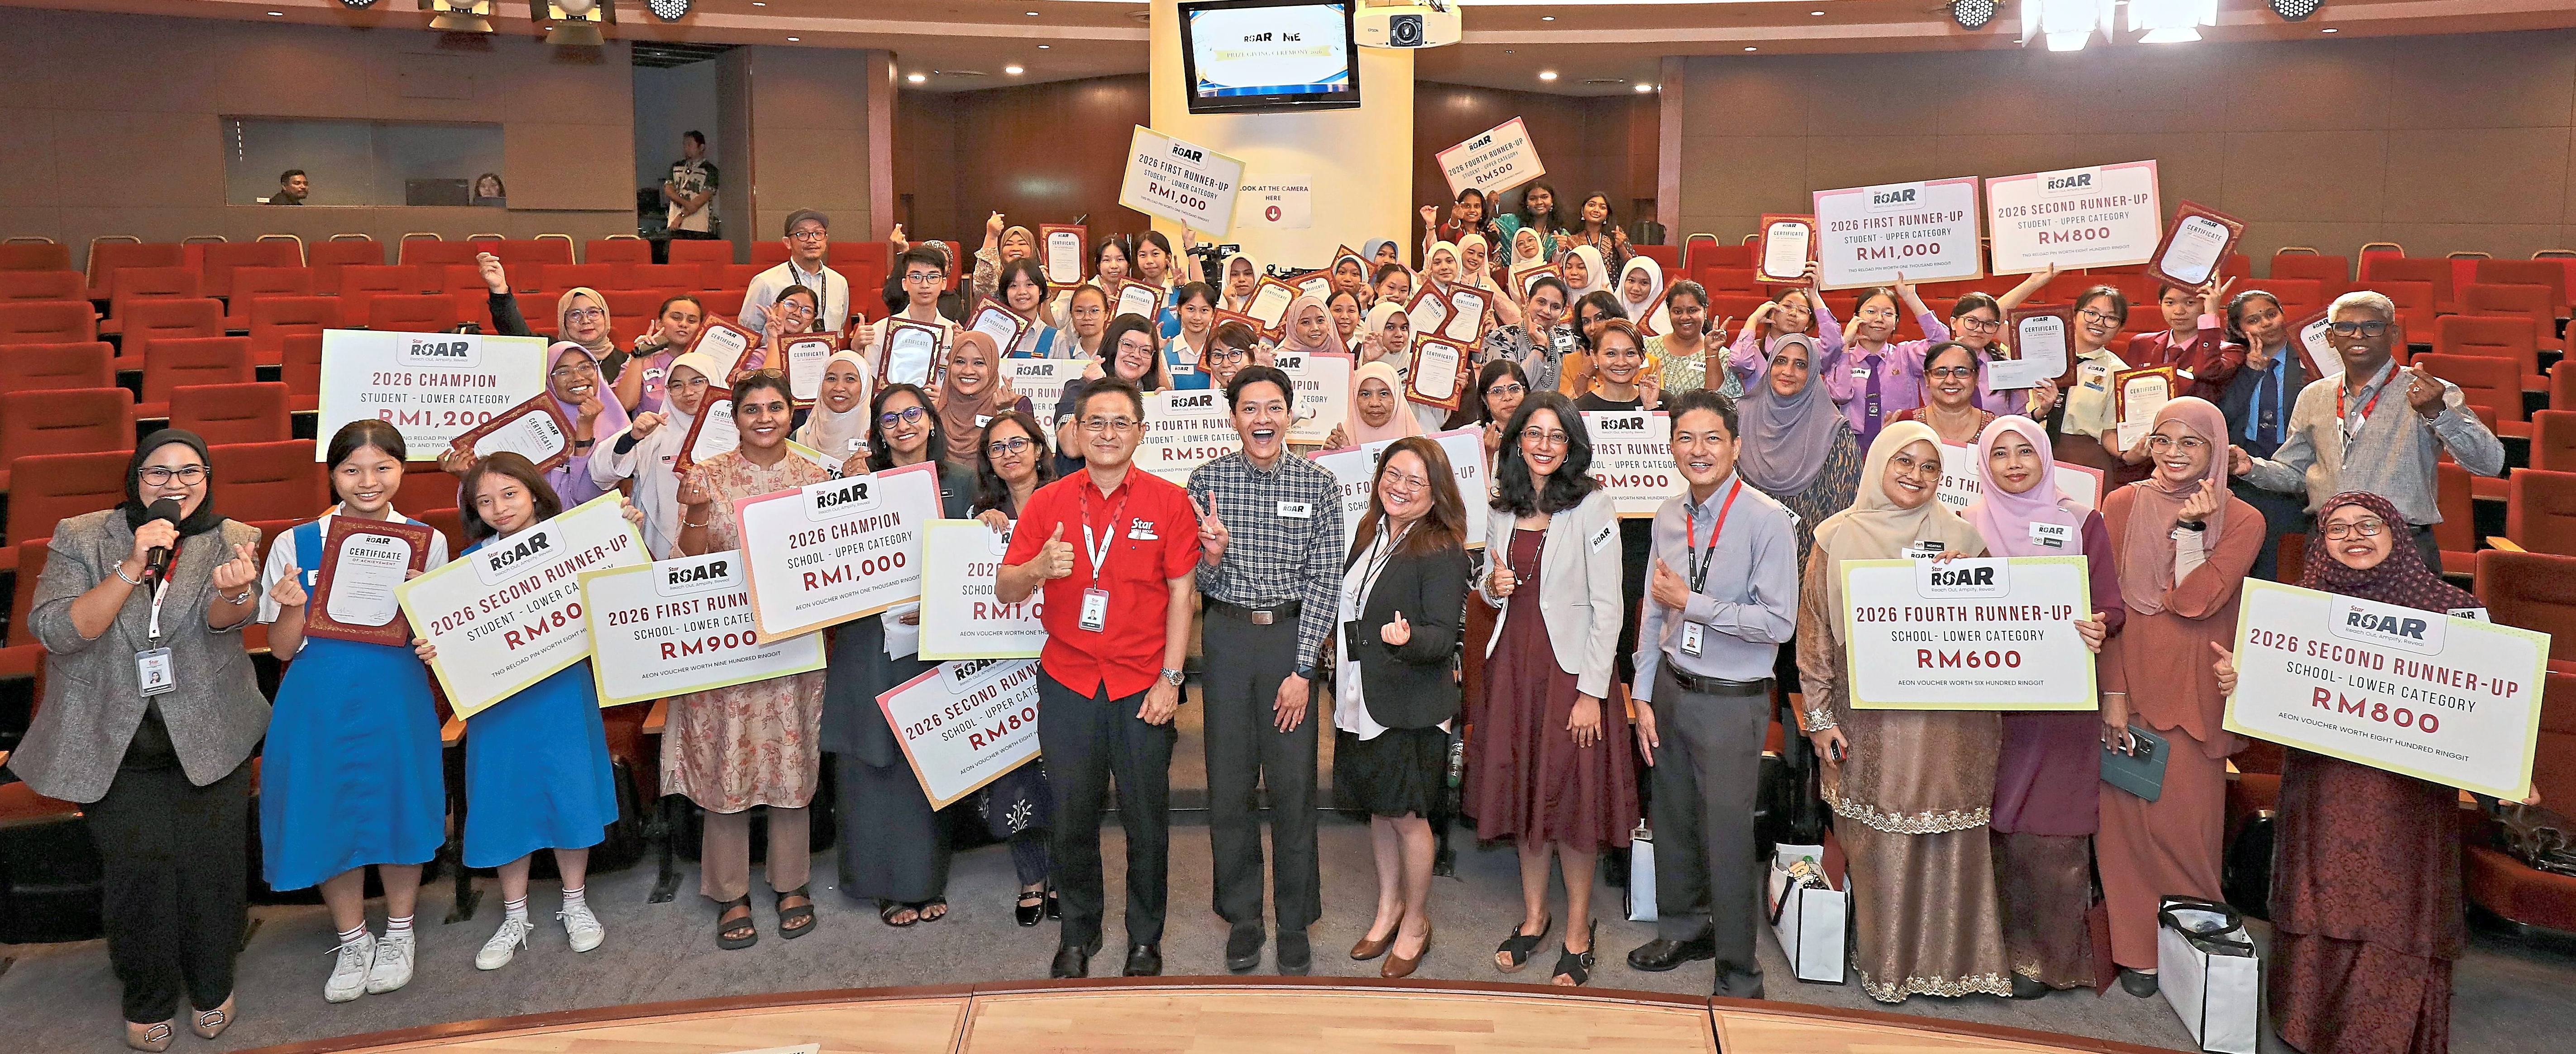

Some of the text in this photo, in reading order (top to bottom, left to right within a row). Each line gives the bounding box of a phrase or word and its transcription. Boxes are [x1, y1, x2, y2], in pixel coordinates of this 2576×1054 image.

[1244, 32, 1272, 42] ROAR
[1172, 143, 1203, 162] ROAR
[1469, 135, 1492, 151] ROAR
[1448, 138, 1523, 176] 2026 FOURTH RUNNER-UP
[1462, 151, 1518, 179] STUDENT UPPER CATEGORY
[1139, 154, 1158, 167] 2026
[1160, 161, 1182, 176] FIRST
[1184, 170, 1228, 191] RUNNER-UP
[1475, 163, 1512, 184] RM500
[2048, 173, 2091, 190] ROAR
[1144, 169, 1218, 200] STUDENT LOWER CATEGORY
[1149, 181, 1206, 210] RM1,000
[1874, 189, 1916, 204] ROAR
[1998, 193, 2148, 218] 2026 SECOND RUNNER-UP
[1831, 210, 1963, 232] 2026 FIRST RUNNER-UP
[2018, 211, 2129, 229] STUDENT UPPER CATEGORY
[1845, 228, 1951, 244] STUDENT UPPER CATEGORY
[2039, 227, 2110, 244] RM800
[2187, 224, 2222, 241] CERTIFICATE
[1857, 243, 1940, 261] RM1,000
[411, 342, 468, 357] ROAR
[373, 372, 496, 387] 2026 CHAMPION
[1016, 364, 1054, 376] ROAR
[361, 393, 510, 404] STUDENT LOWER CATEGORY
[1171, 395, 1212, 407] ROAR
[379, 409, 492, 428] RM1,200
[545, 420, 559, 435] ROAR
[1156, 420, 1197, 431] FOURTH
[1601, 417, 1644, 429] ROAR
[529, 418, 554, 450] CERTIFICATE
[1142, 434, 1208, 444] STUDENT LOWER
[1162, 447, 1229, 461] RM500
[1594, 473, 1668, 489] RM900
[816, 483, 868, 509] ROAR
[789, 511, 900, 549] 2026 CHAMPION
[1131, 517, 1154, 530] Star
[1593, 527, 1611, 546] ROAR
[349, 548, 401, 560] CERTIFICATE
[490, 532, 550, 571] ROAR
[788, 531, 912, 569] SCHOOL UPPER CATEGORY
[669, 561, 728, 585] ROAR
[803, 552, 906, 591] RM1,000
[1931, 567, 1994, 586] ROAR
[431, 534, 627, 636] 2026 SECOND RUNNER-UP
[467, 590, 563, 641] STUDENT LOWER
[608, 599, 699, 626] 2026 FIRST
[1857, 605, 2071, 622] 2026 FOURTH RUNNER-UP
[634, 618, 719, 640] SCHOOL- LOWER
[1892, 630, 2044, 642] SCHOOL- LOWER CATEGORY
[2346, 612, 2427, 641] ROAR
[660, 630, 757, 660] RM900
[660, 667, 689, 675] VOUCHER
[728, 655, 756, 664] HUNDRED
[757, 651, 781, 659] RINGGIT
[1917, 649, 2021, 668] RM600
[2250, 628, 2518, 698] 2026 SECOND RUNNER-UP
[2287, 661, 2476, 712] SCHOOL- LOWER CATEGORY
[906, 685, 997, 740] 2026 SECOND
[2312, 687, 2439, 733] RM800
[942, 699, 1015, 741] SCHOOL UPPER
[2278, 712, 2469, 762] AEON VOUCHER WORTH EIGHT HUNDRED RINGGIT
